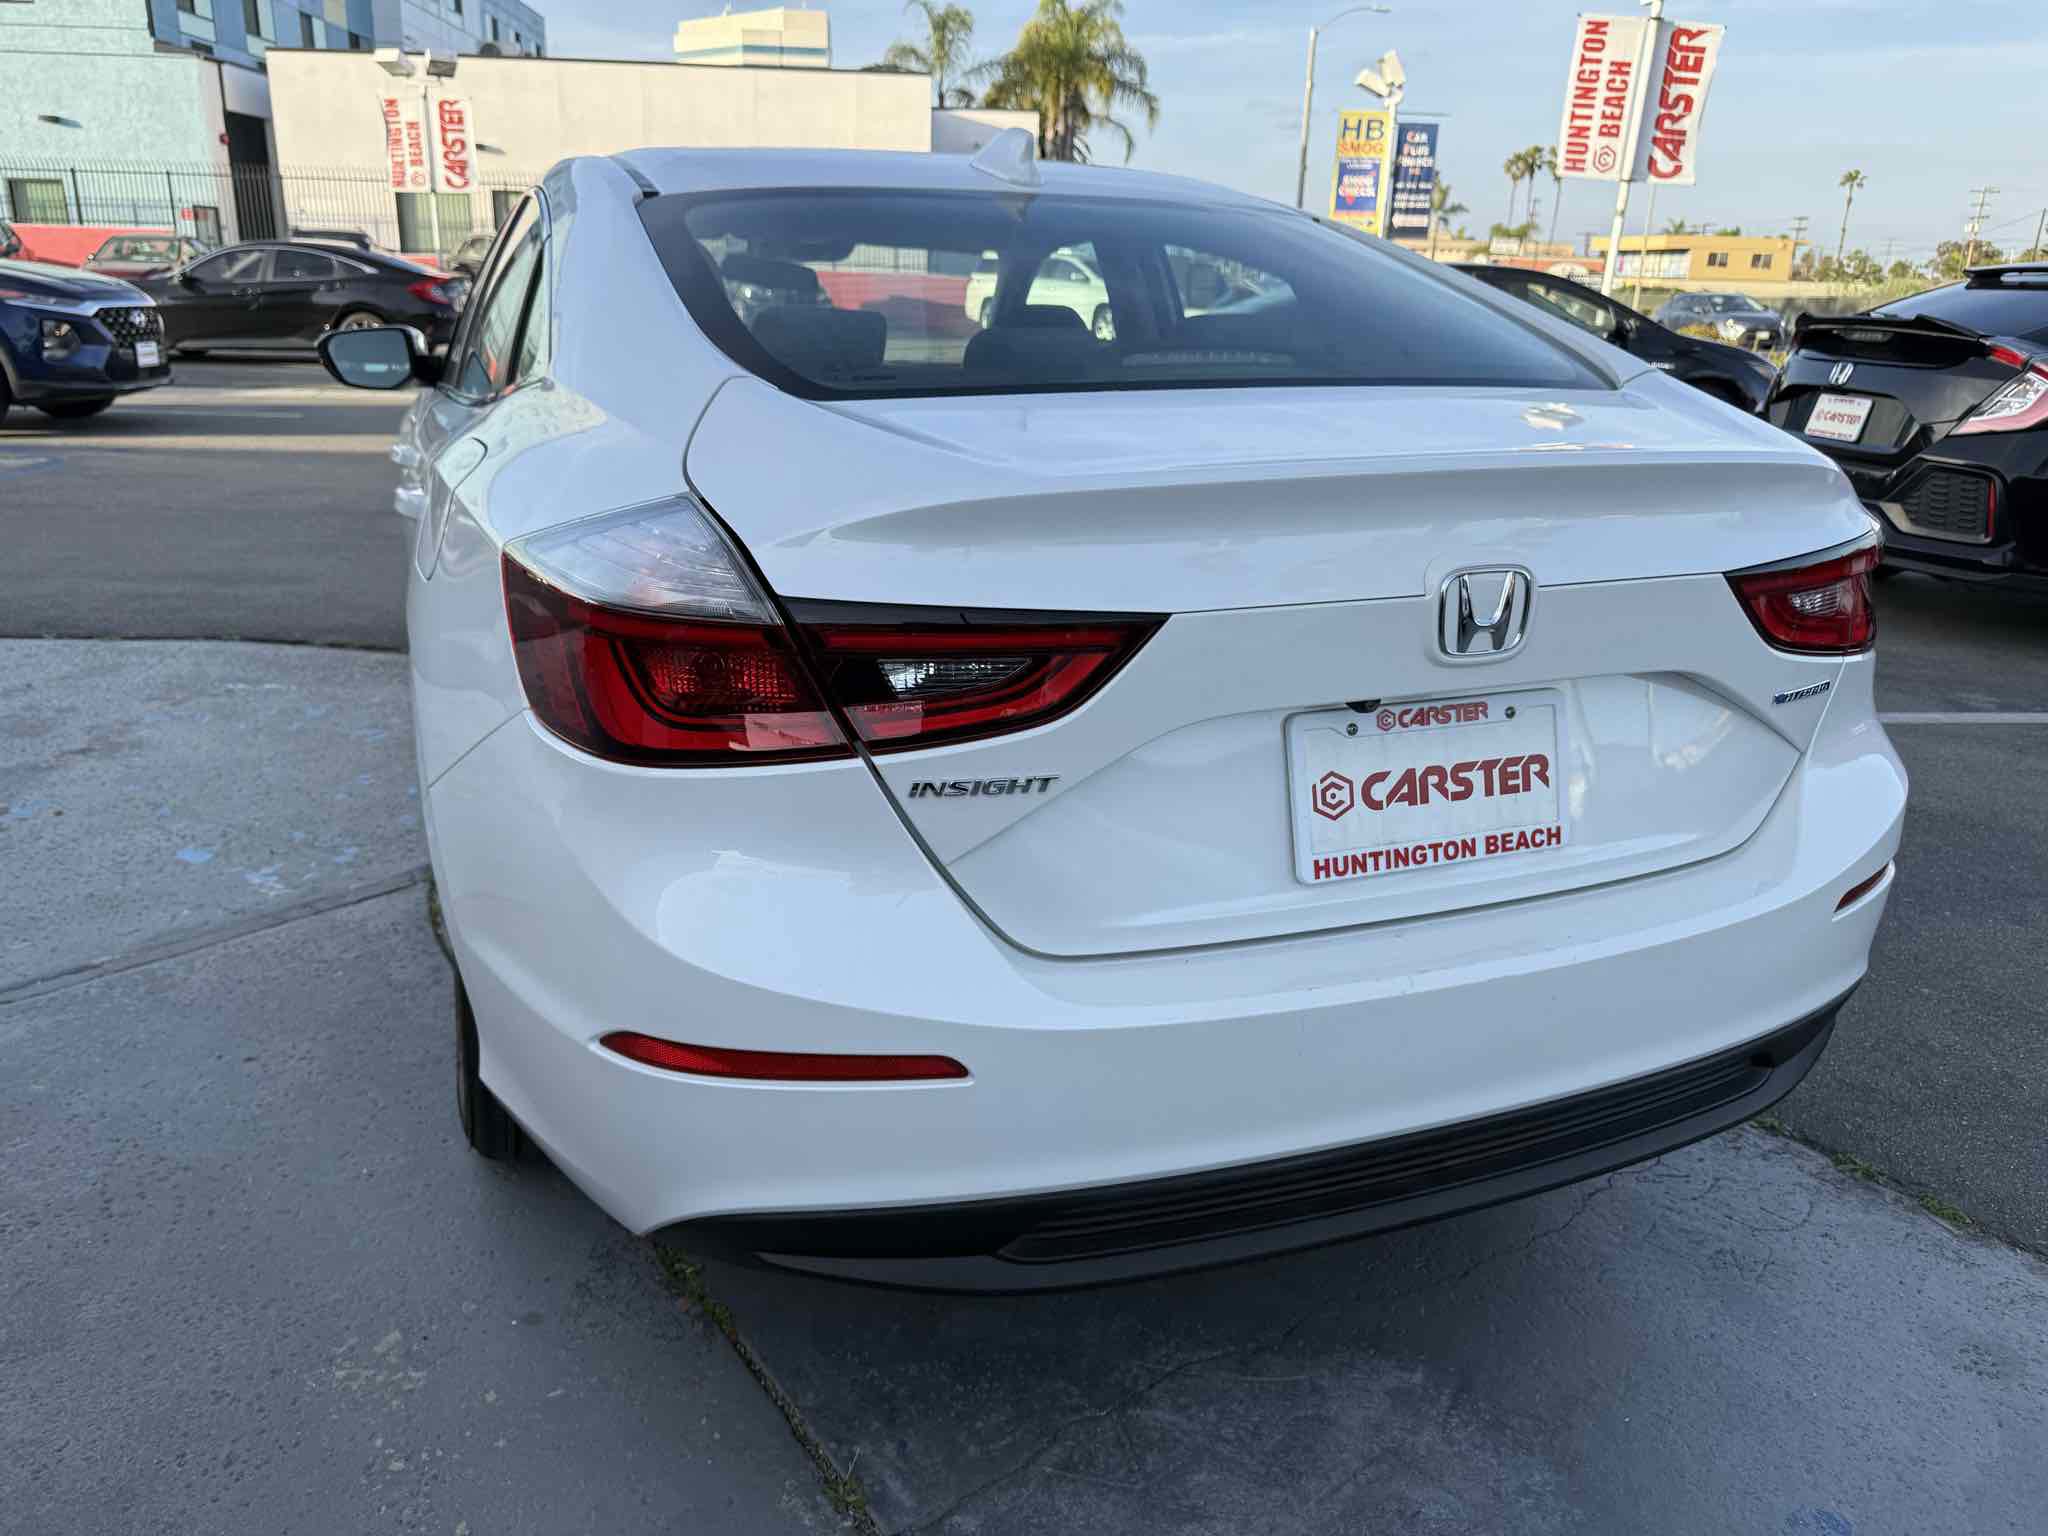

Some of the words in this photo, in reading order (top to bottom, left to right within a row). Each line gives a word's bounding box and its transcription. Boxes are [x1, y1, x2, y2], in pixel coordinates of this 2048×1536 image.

[1565, 20, 1609, 172] HUNTINGTON
[1598, 61, 1632, 138] BEACH
[1648, 26, 1712, 178] CARSTER
[384, 99, 405, 187] HUNTINGTON
[406, 121, 424, 166] BEACH
[439, 99, 469, 188] CARSTER
[1340, 142, 1384, 154] SMOG
[1343, 119, 1384, 140] HB
[1398, 701, 1488, 728] CARSTER
[909, 775, 1060, 799] INSIGHT
[1361, 754, 1550, 811] CARSTER
[1313, 838, 1476, 880] HUNTINGTON
[1485, 826, 1561, 855] BEACH
